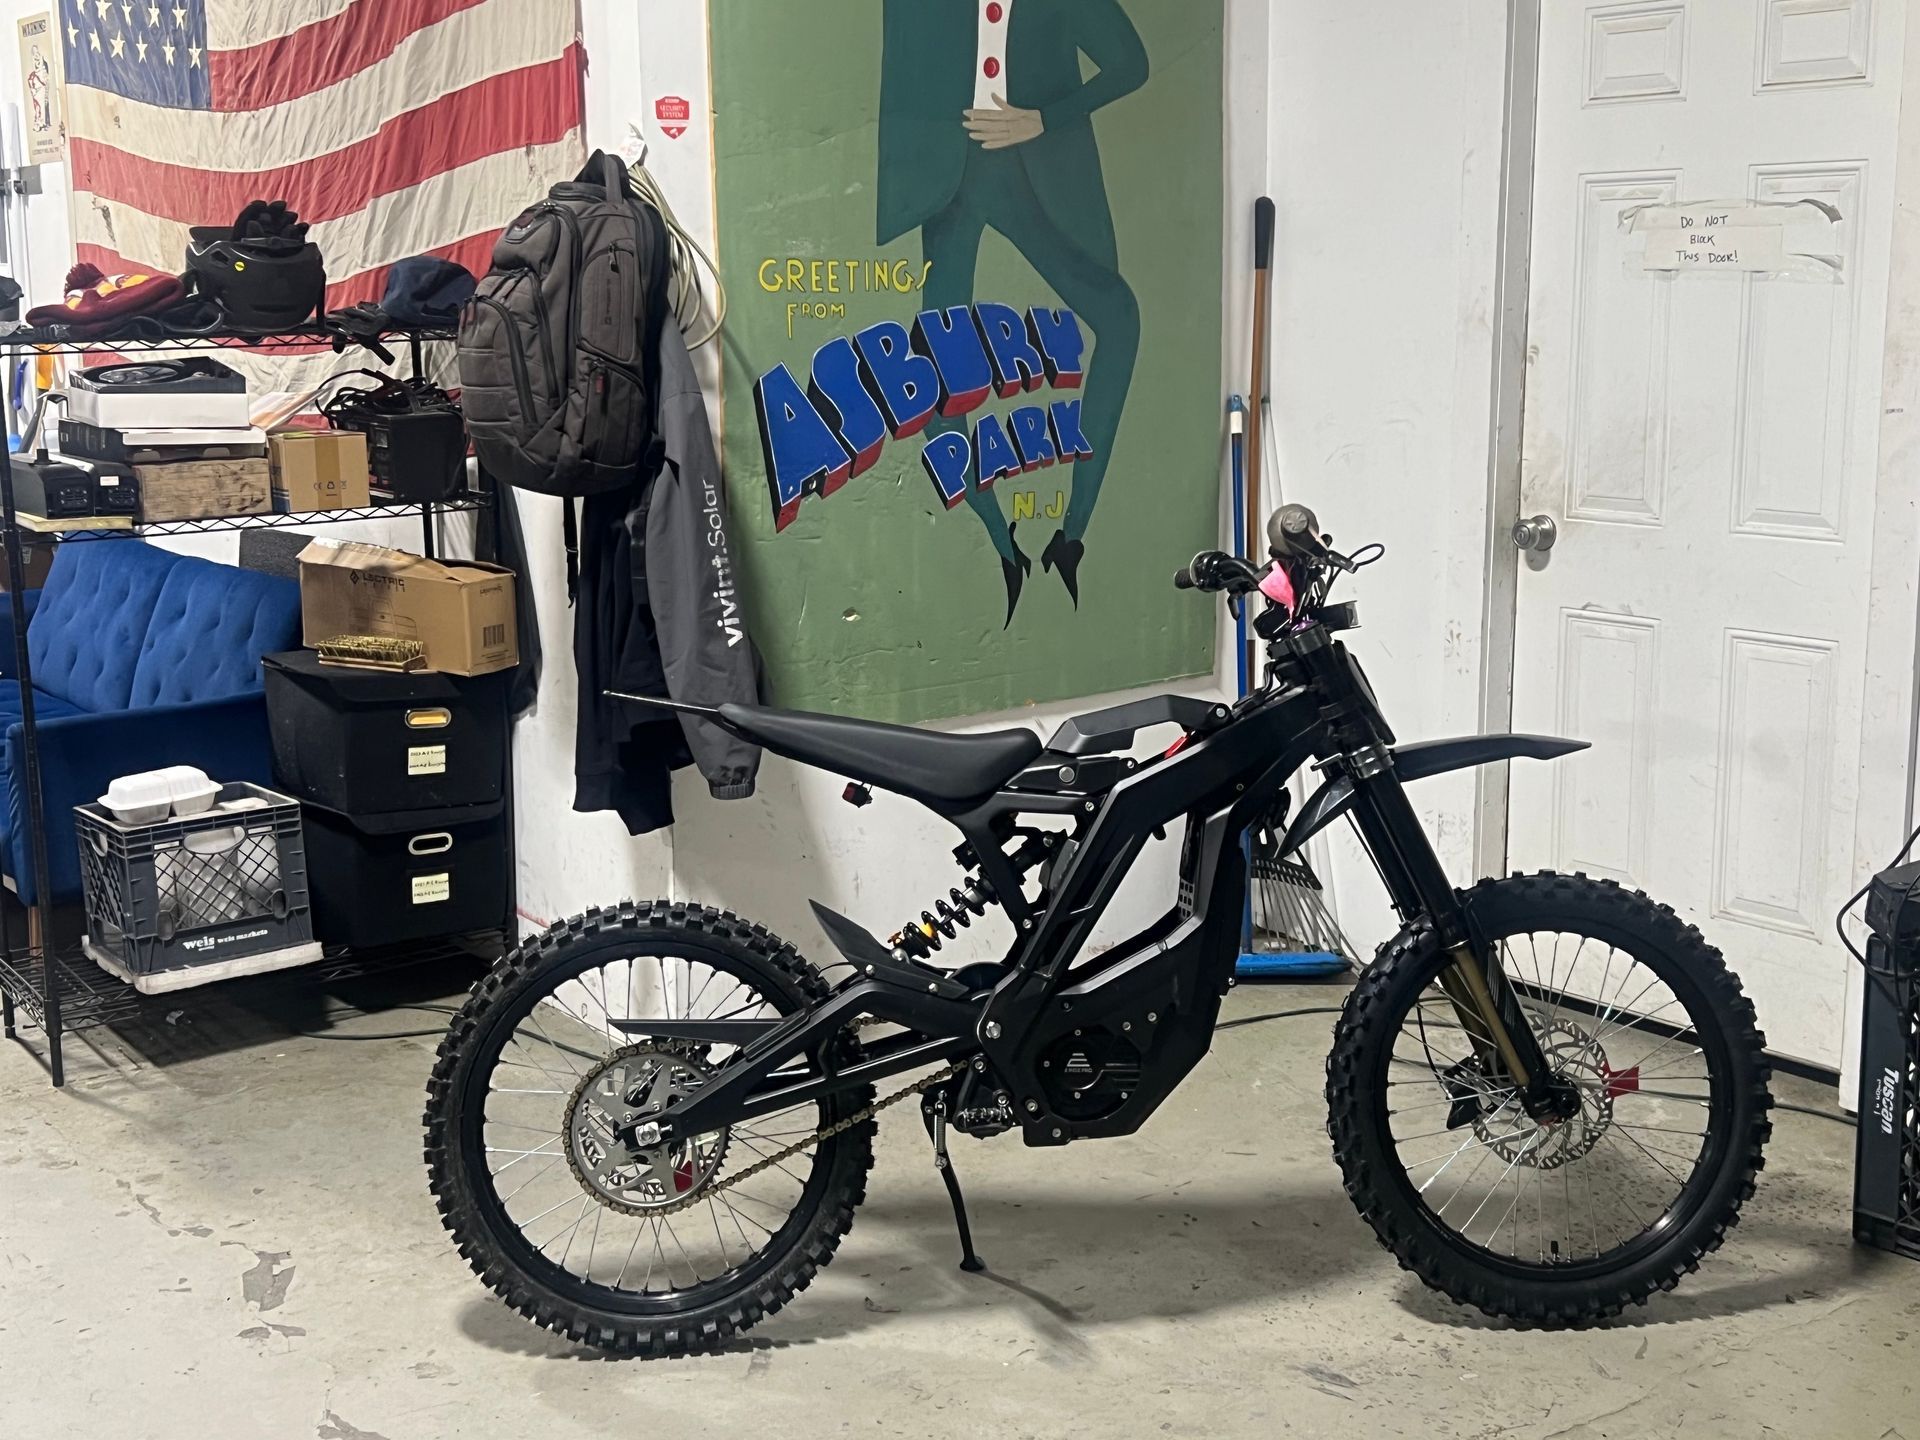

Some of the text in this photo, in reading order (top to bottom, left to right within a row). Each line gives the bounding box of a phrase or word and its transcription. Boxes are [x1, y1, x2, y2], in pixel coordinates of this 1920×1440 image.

[1680, 214, 1729, 229] DO NOT
[758, 259, 933, 293] GREETINGS
[787, 302, 846, 340] FROM
[754, 302, 1085, 533] ASBURY
[922, 399, 1094, 511] PARK
[182, 936, 215, 950] weis
[1880, 1067, 1900, 1134] Tuscan
